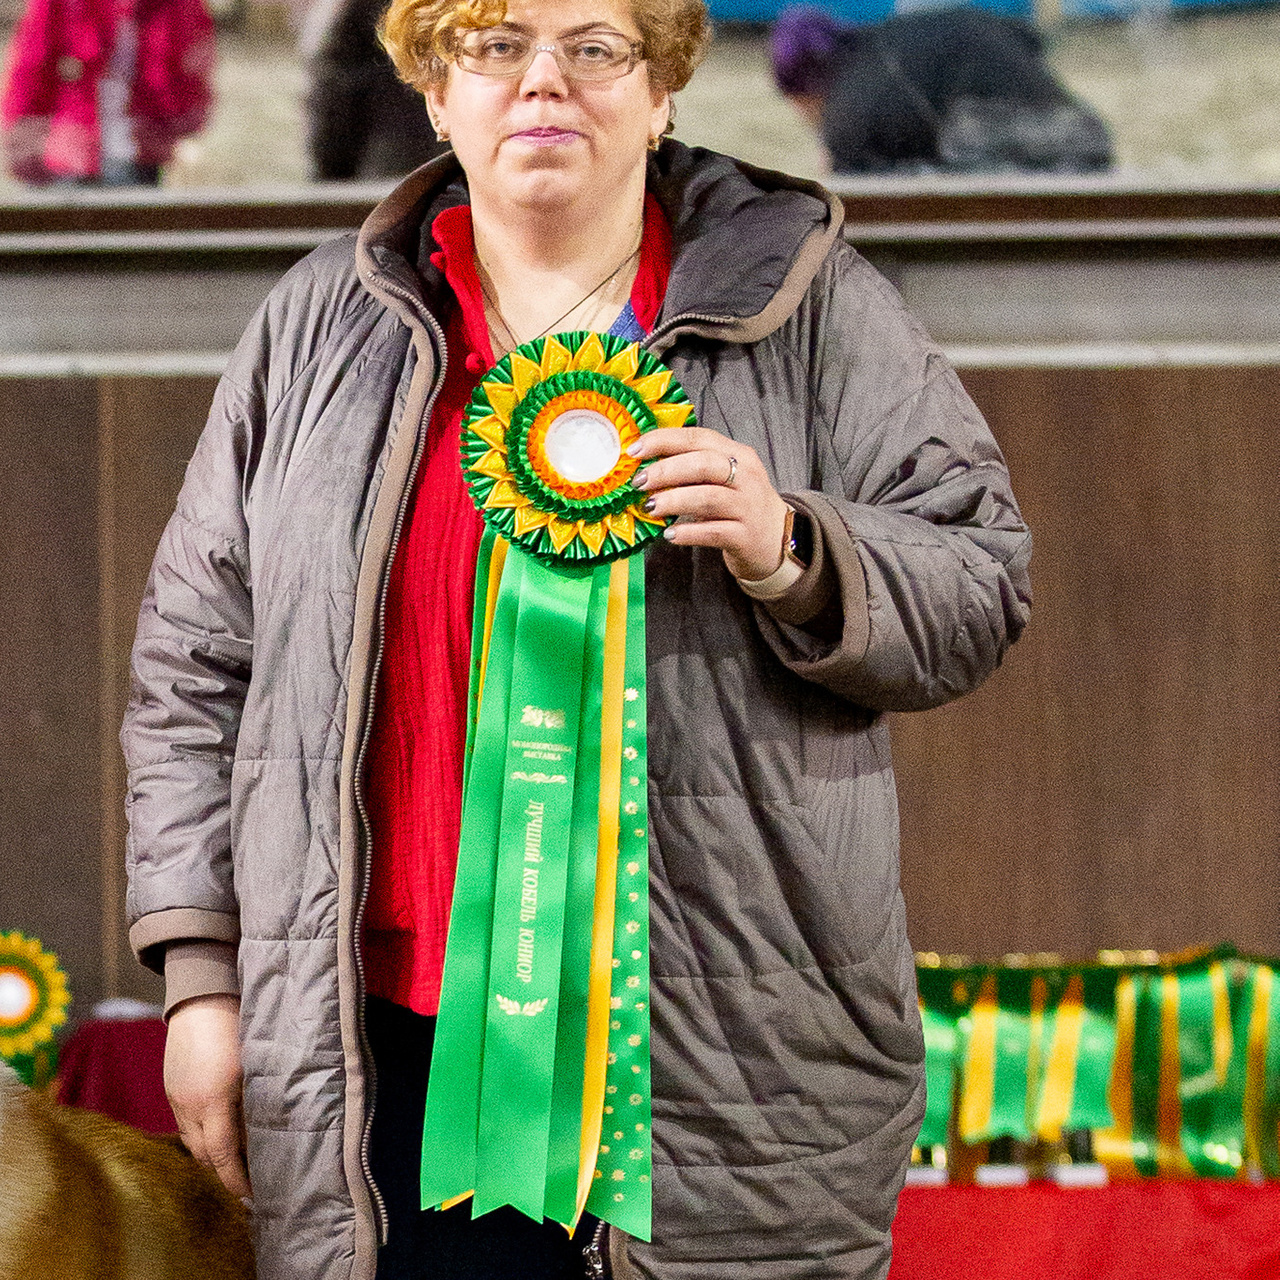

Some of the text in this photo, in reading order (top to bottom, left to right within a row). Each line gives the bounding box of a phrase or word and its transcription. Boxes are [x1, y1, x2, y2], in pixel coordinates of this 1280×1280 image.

[516, 799, 545, 983] ЛУЧШИЙ КОБЕЛЬ ЮНИОР
